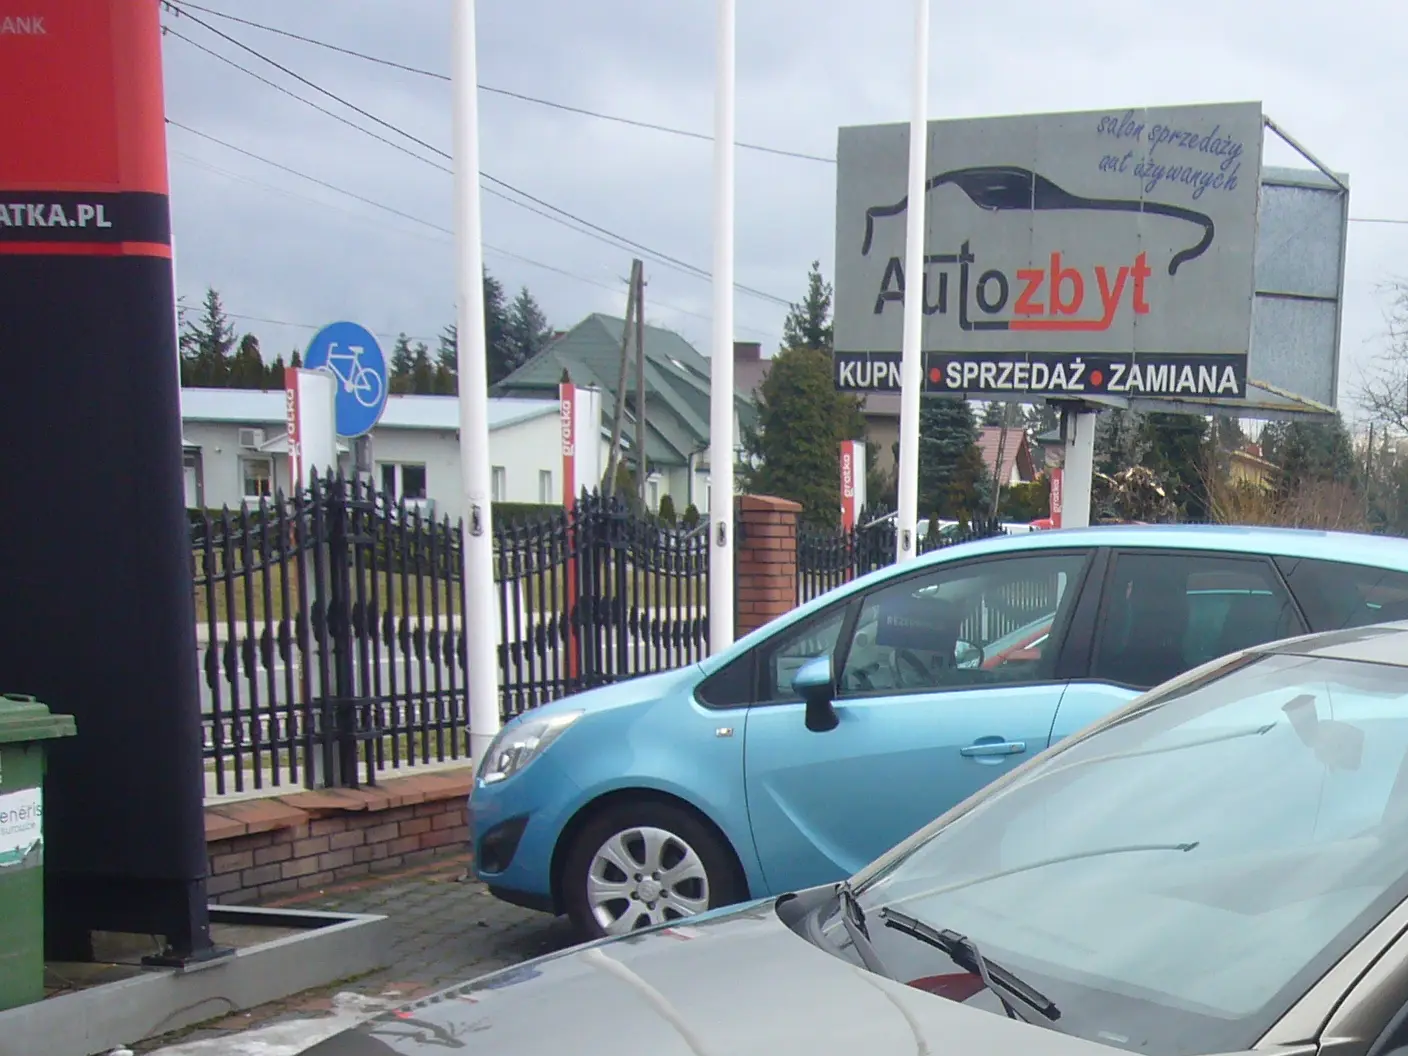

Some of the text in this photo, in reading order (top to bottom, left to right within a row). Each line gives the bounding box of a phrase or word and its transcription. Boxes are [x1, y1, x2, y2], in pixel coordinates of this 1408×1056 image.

[0, 16, 46, 34] ANK
[1097, 109, 1243, 170] salon sprzedaży
[1099, 151, 1241, 200] aut używanych
[839, 357, 1239, 394] KUPN SPRZEDAŻ ZAMIANA
[561, 400, 574, 457] gratka
[843, 454, 854, 498] gratka
